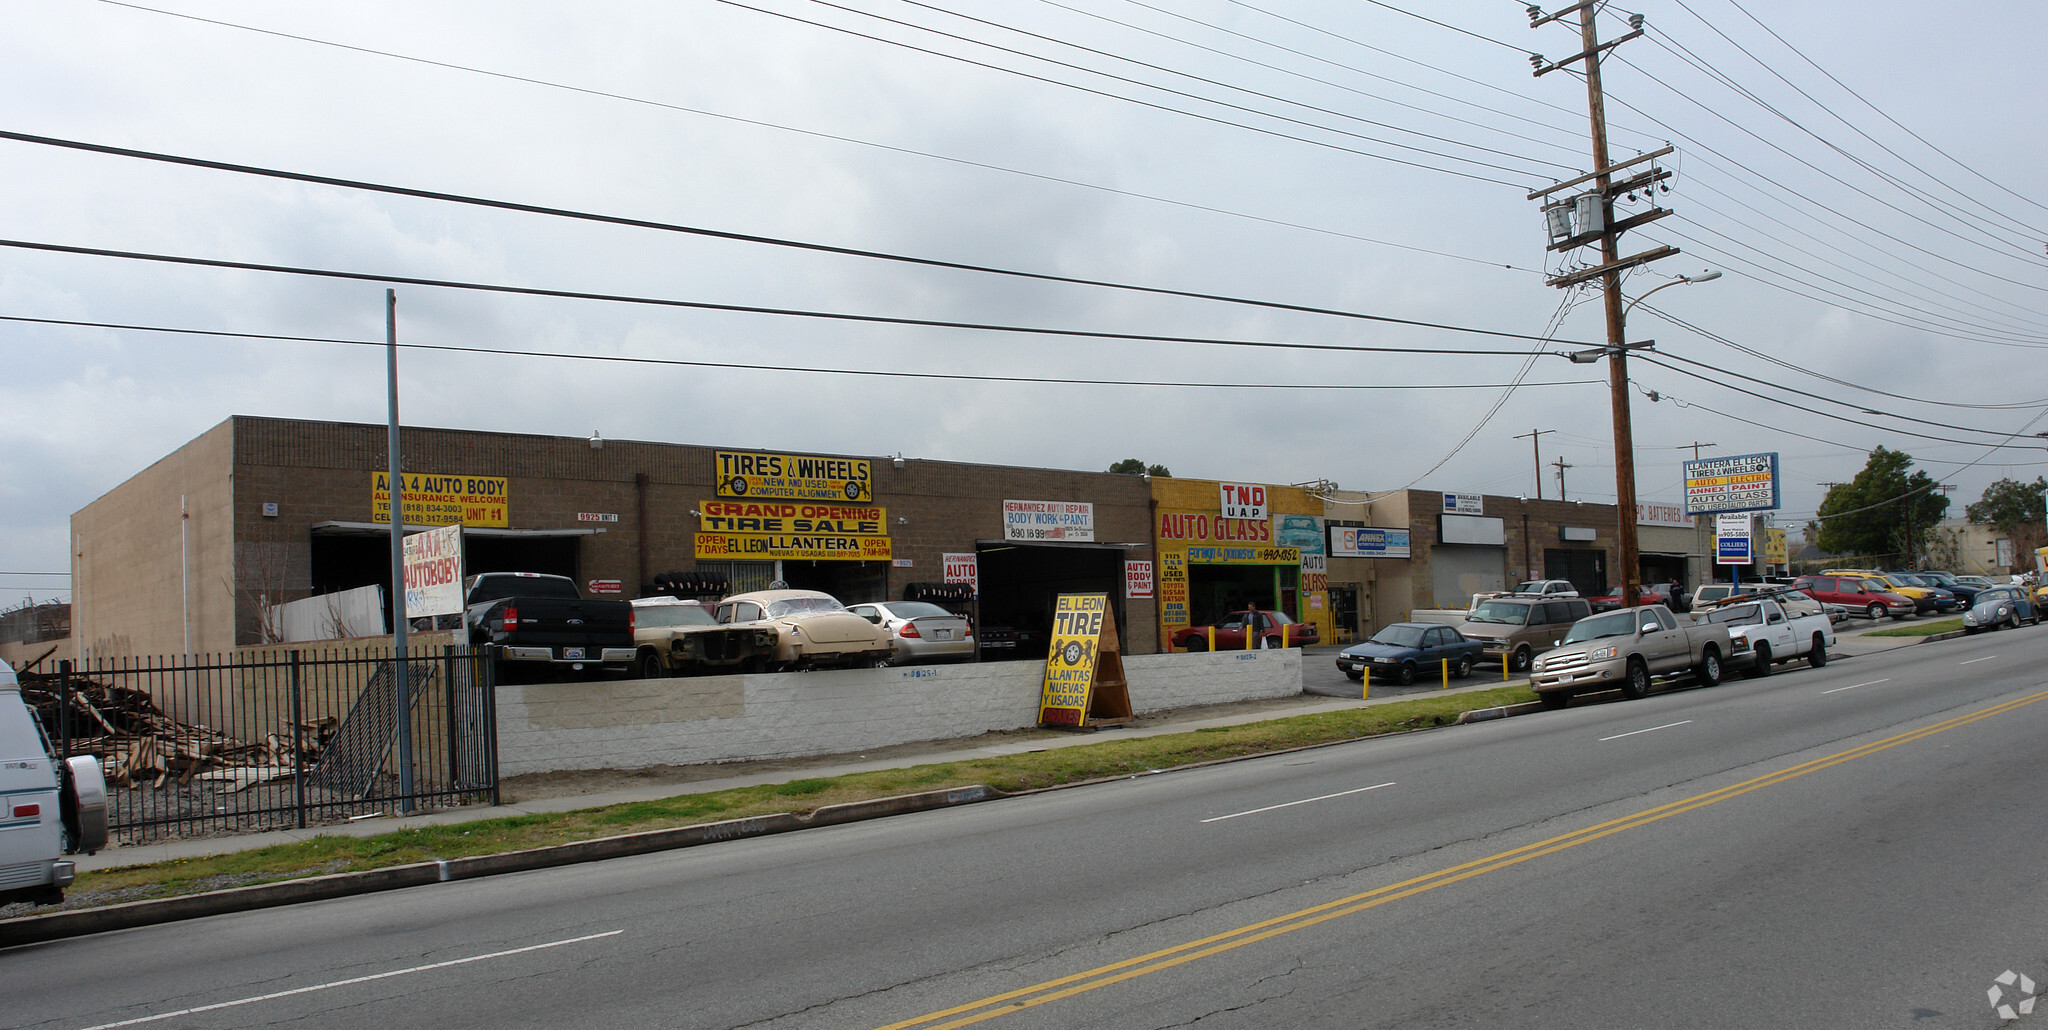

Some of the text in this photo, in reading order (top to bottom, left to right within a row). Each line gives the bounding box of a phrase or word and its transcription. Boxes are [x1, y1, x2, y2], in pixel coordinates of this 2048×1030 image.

[719, 453, 782, 476] TIRES
[798, 458, 868, 481] WHEELS
[1688, 460, 1730, 470] LLANTERA
[1745, 456, 1768, 465] LEON
[1690, 469, 1714, 478] TIRES
[1722, 464, 1756, 475] WHEELS
[411, 476, 420, 492] 4
[424, 477, 462, 494] AUTO
[468, 479, 504, 495] BODY
[764, 478, 828, 489] NEW AND USED
[1694, 473, 1771, 486] AUTO ELECTRIC
[750, 487, 842, 499] COMPUTER ALIGNMENT
[1690, 482, 1768, 494] ANNEX PAINT
[401, 494, 456, 503] NSURANCE
[460, 496, 506, 504] WELCOME
[1691, 491, 1768, 504] AUTO GLASS
[403, 504, 424, 512] (818)
[466, 508, 502, 520] UNIT #1
[705, 503, 880, 521] GRAND OPENING
[1005, 502, 1088, 514] HERNANDEZ AUTO REPAIR
[1648, 506, 1680, 522] BATTERIES
[1008, 512, 1032, 524] BODY
[1035, 513, 1058, 524] WORK
[1064, 514, 1088, 525] PAINT
[706, 517, 880, 534] TIRE SALE
[1160, 514, 1270, 542] AUTO GLASS
[698, 535, 726, 544] OPEN
[1011, 529, 1044, 538] 890 1899
[1359, 533, 1384, 542] ANNEX
[697, 545, 728, 554] 7 DAYS
[728, 538, 768, 554] EL LEON
[768, 536, 861, 550] LLANTERA
[864, 539, 886, 548] OPEN
[1127, 563, 1150, 572] AUTO
[1302, 556, 1324, 569] AUTO
[946, 564, 976, 577] AUTO
[1128, 572, 1150, 580] BODY
[1128, 582, 1151, 590] & PAINT
[1302, 574, 1328, 592] GLASS
[1058, 598, 1104, 610] EL LEON
[1056, 612, 1102, 636] TIRE
[1048, 669, 1090, 682] LLANTAS
[1048, 682, 1085, 694] NUEVAS
[1044, 694, 1085, 707] Y USADAS
[1044, 708, 1080, 724] BRAKES
